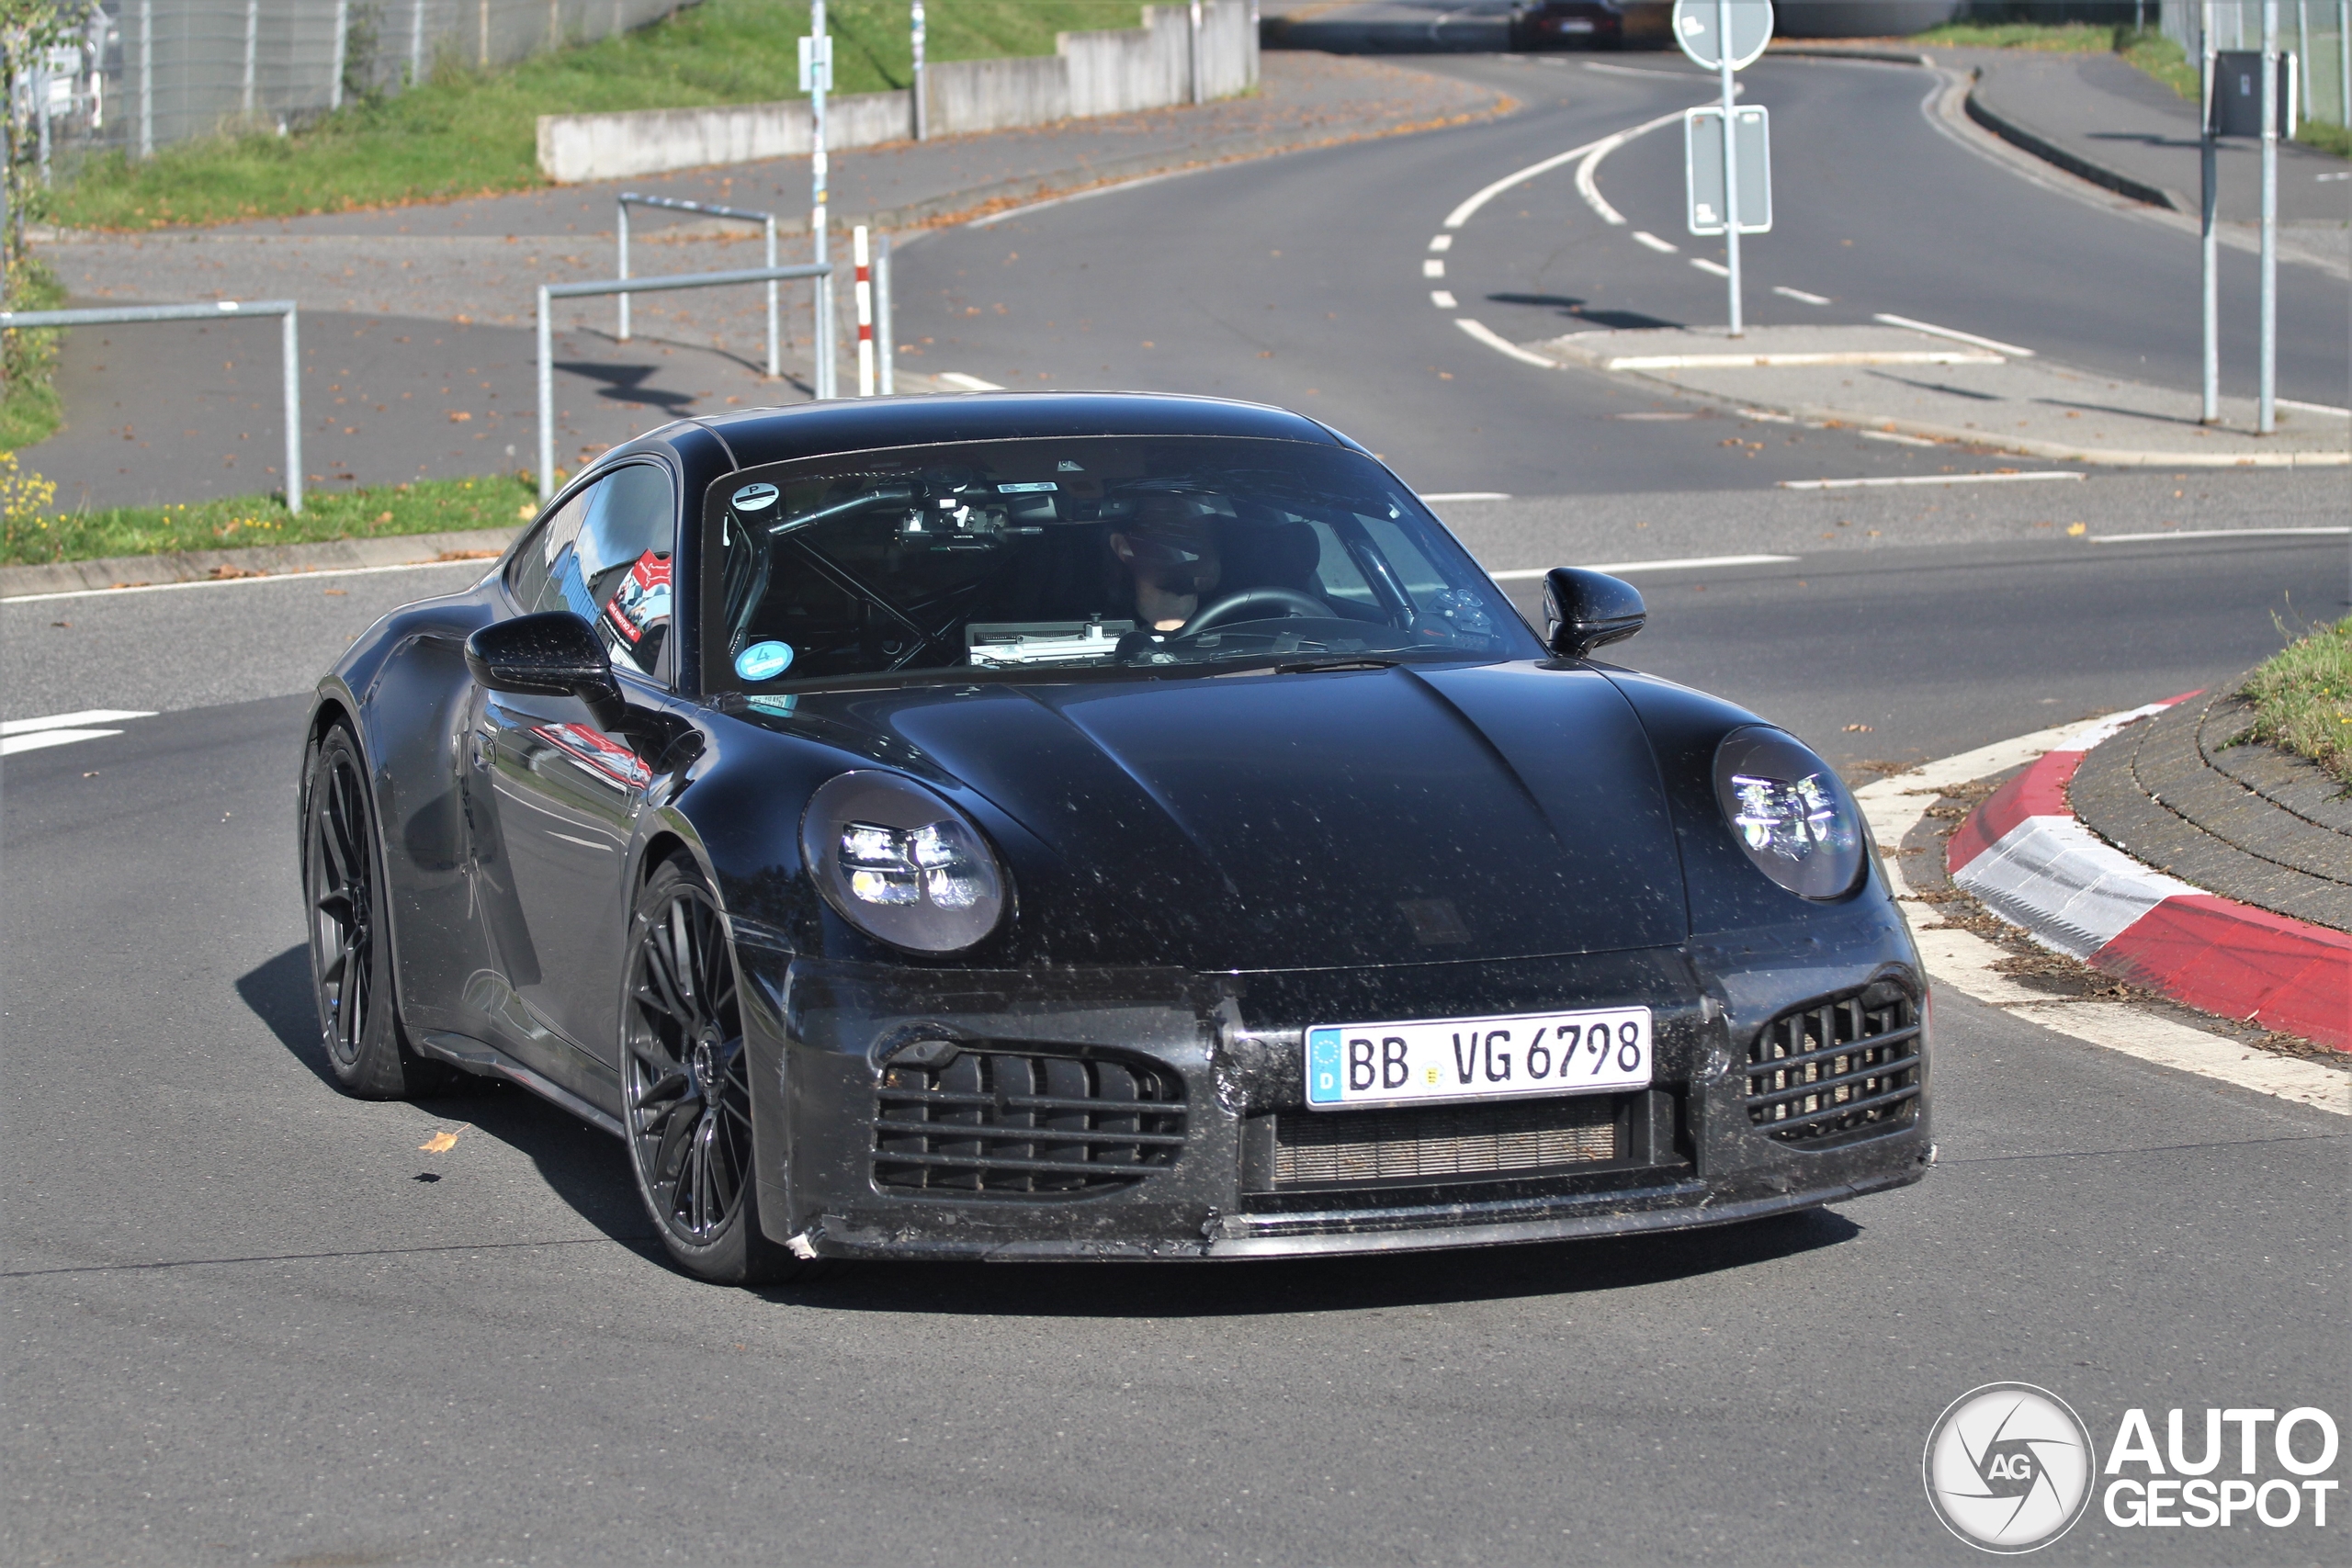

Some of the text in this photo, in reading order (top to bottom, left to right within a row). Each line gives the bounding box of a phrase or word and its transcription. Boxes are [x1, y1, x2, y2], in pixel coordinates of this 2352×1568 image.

[749, 485, 759, 493] P
[757, 647, 770, 660] 4
[1348, 1021, 1641, 1091] BB VG 6798
[1319, 1072, 1333, 1090] D
